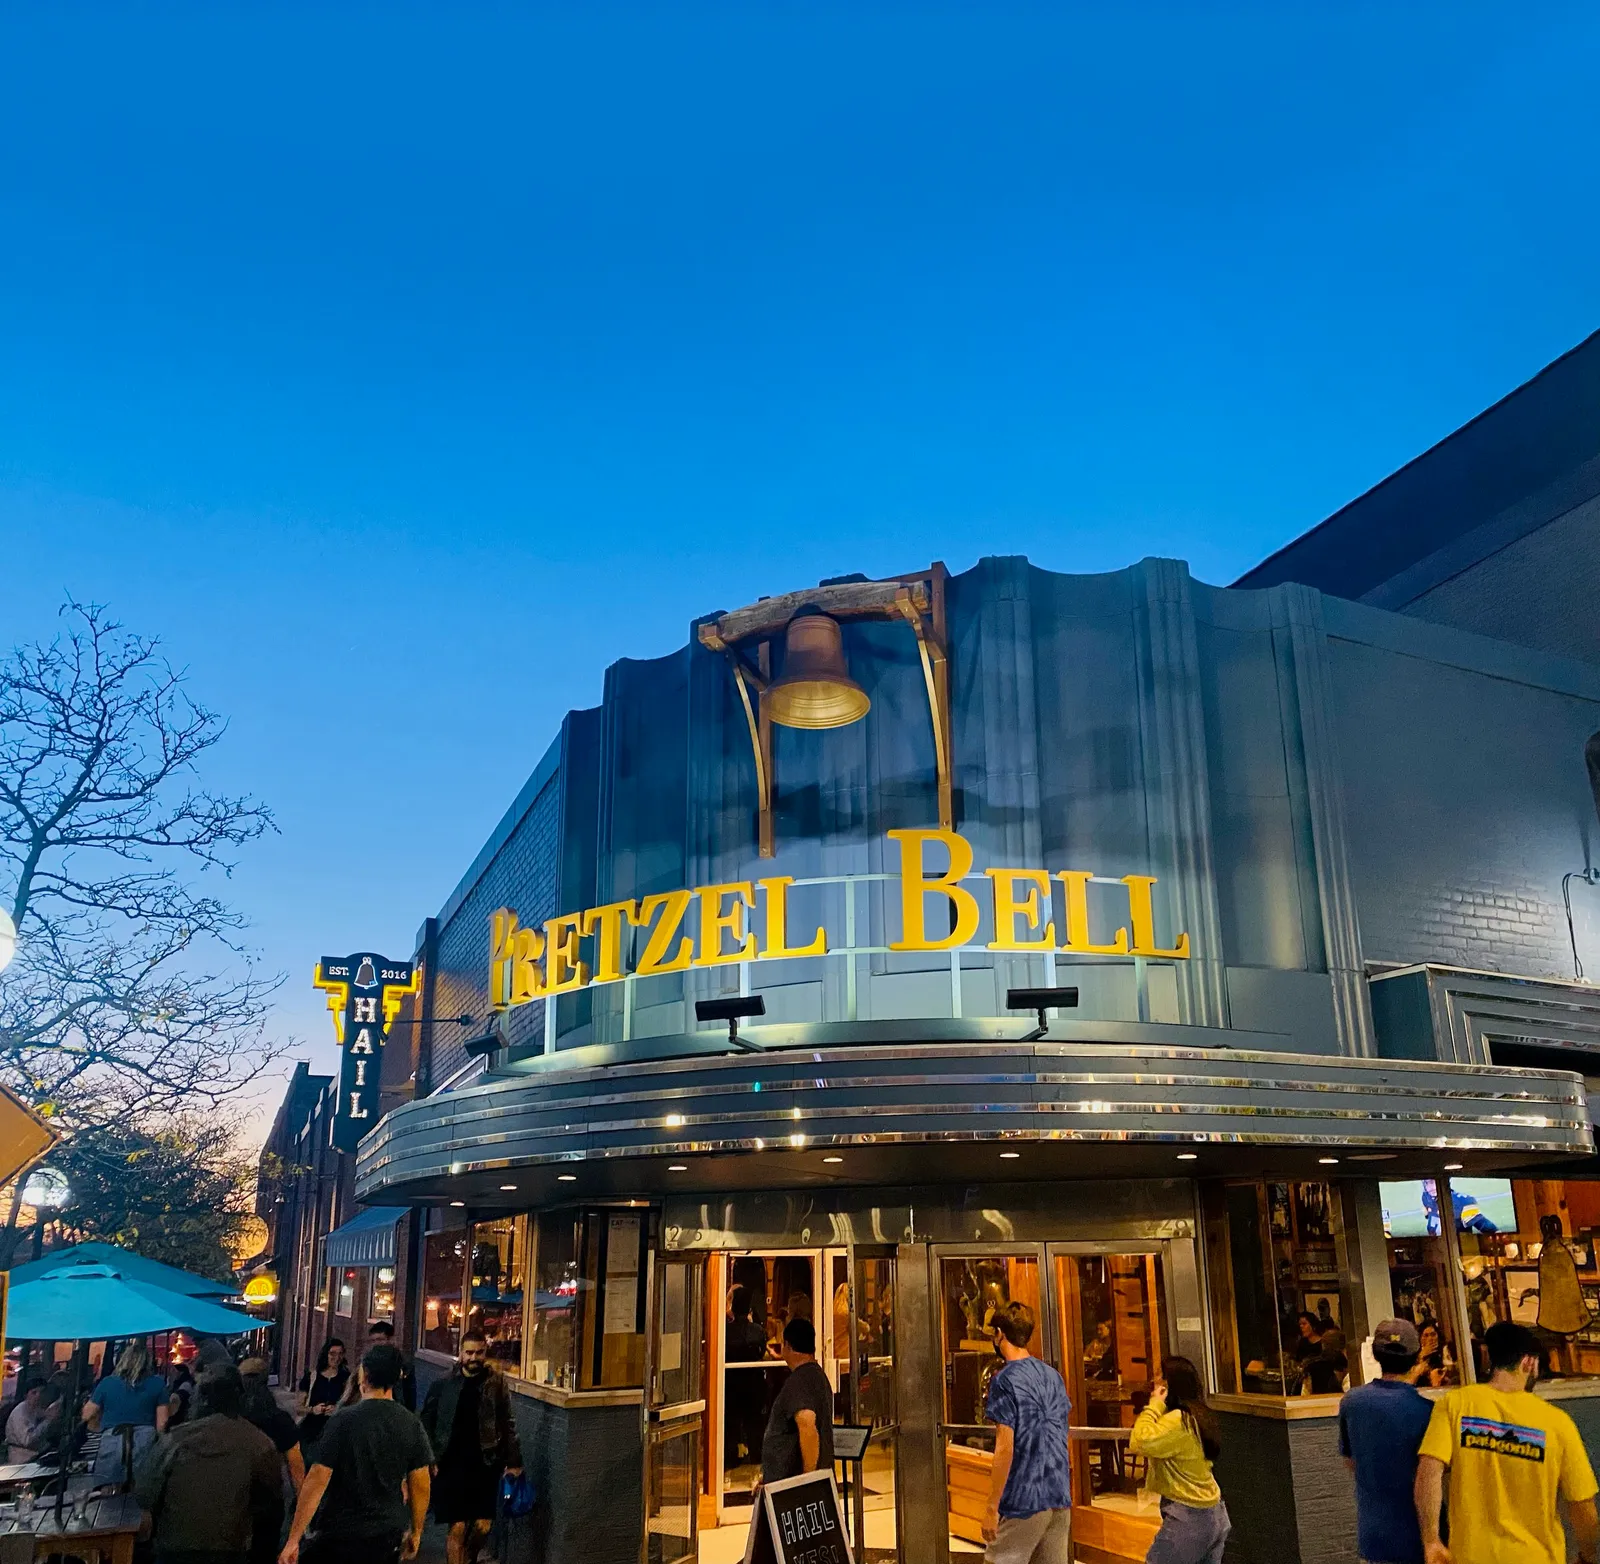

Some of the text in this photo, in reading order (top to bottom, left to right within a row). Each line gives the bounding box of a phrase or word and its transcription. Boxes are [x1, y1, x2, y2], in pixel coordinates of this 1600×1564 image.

[488, 829, 1190, 1012] PRETZEL BELL
[328, 966, 407, 980] EST. 2016
[350, 997, 378, 1119] HAIL
[781, 1500, 835, 1545] HAIL
